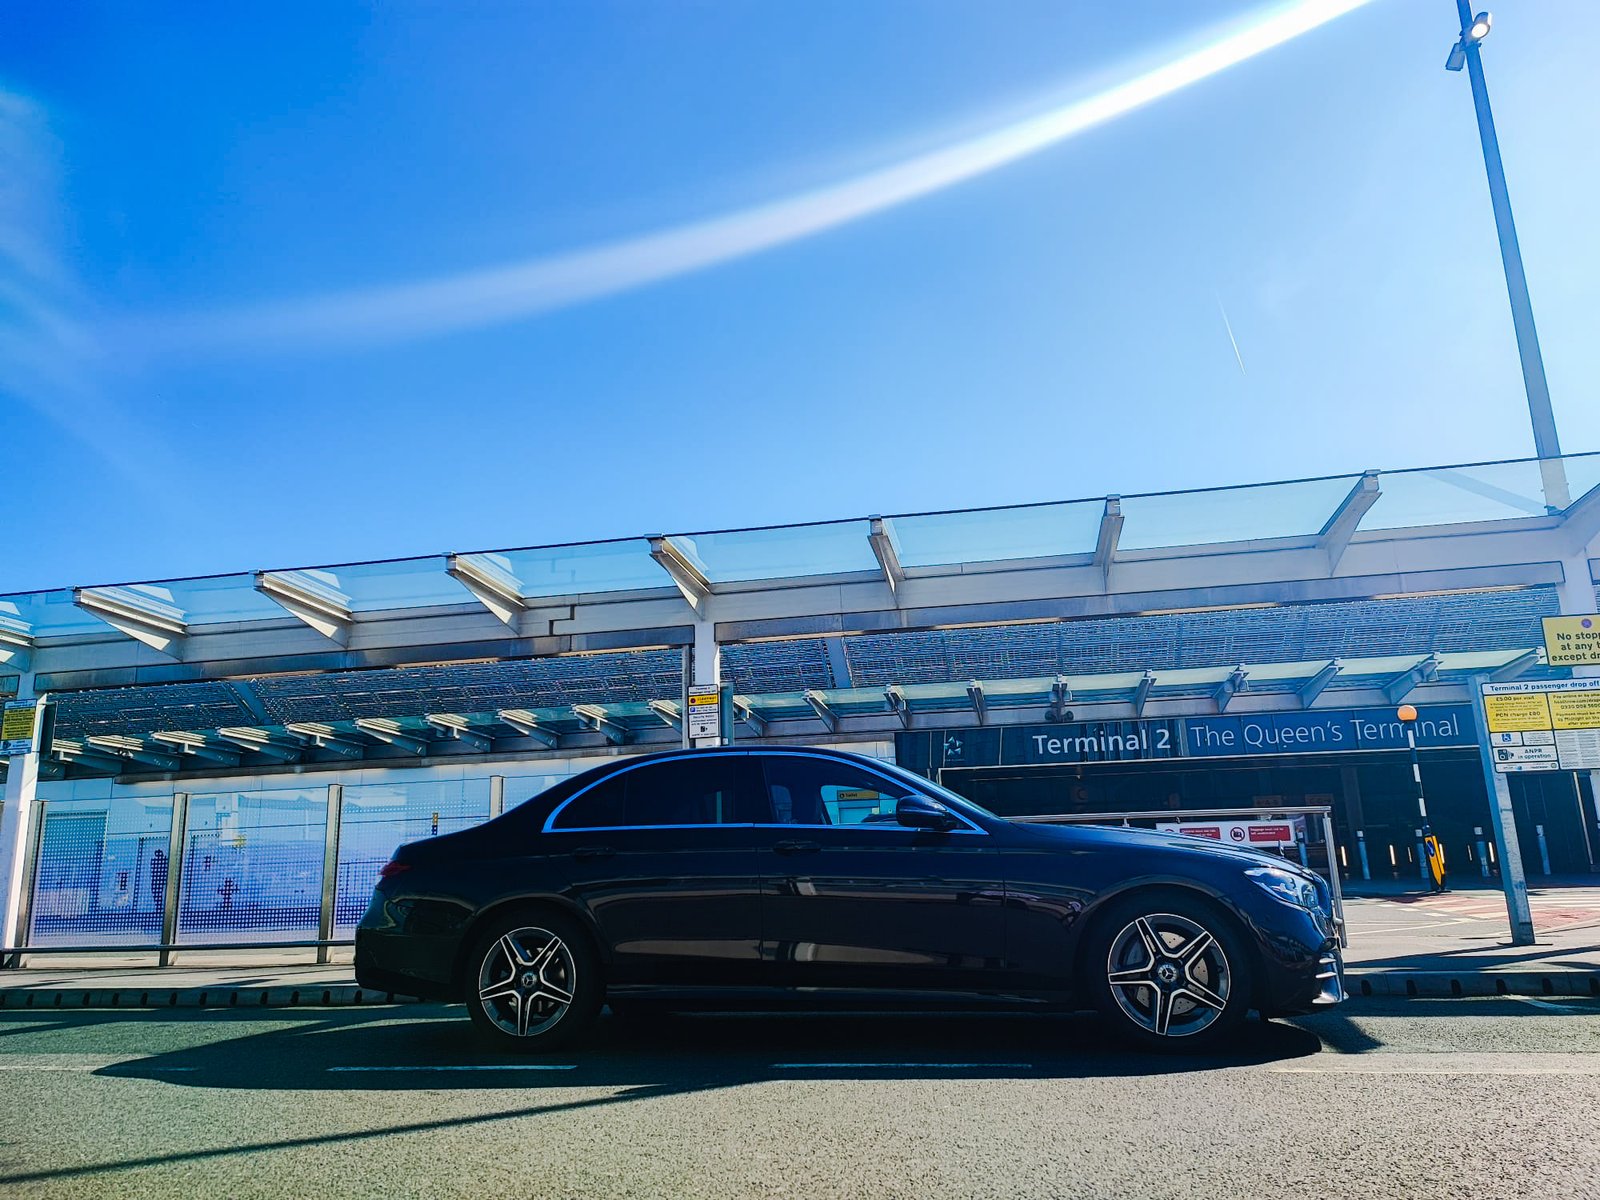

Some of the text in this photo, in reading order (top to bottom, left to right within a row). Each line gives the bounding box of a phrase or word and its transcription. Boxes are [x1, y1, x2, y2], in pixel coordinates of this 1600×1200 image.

[1556, 632, 1572, 641] No
[1560, 642, 1571, 651] at
[1574, 643, 1593, 651] any
[1551, 652, 1587, 662] except
[1531, 683, 1568, 691] passenger
[1032, 728, 1171, 755] Terminal 2
[1190, 726, 1235, 748] The
